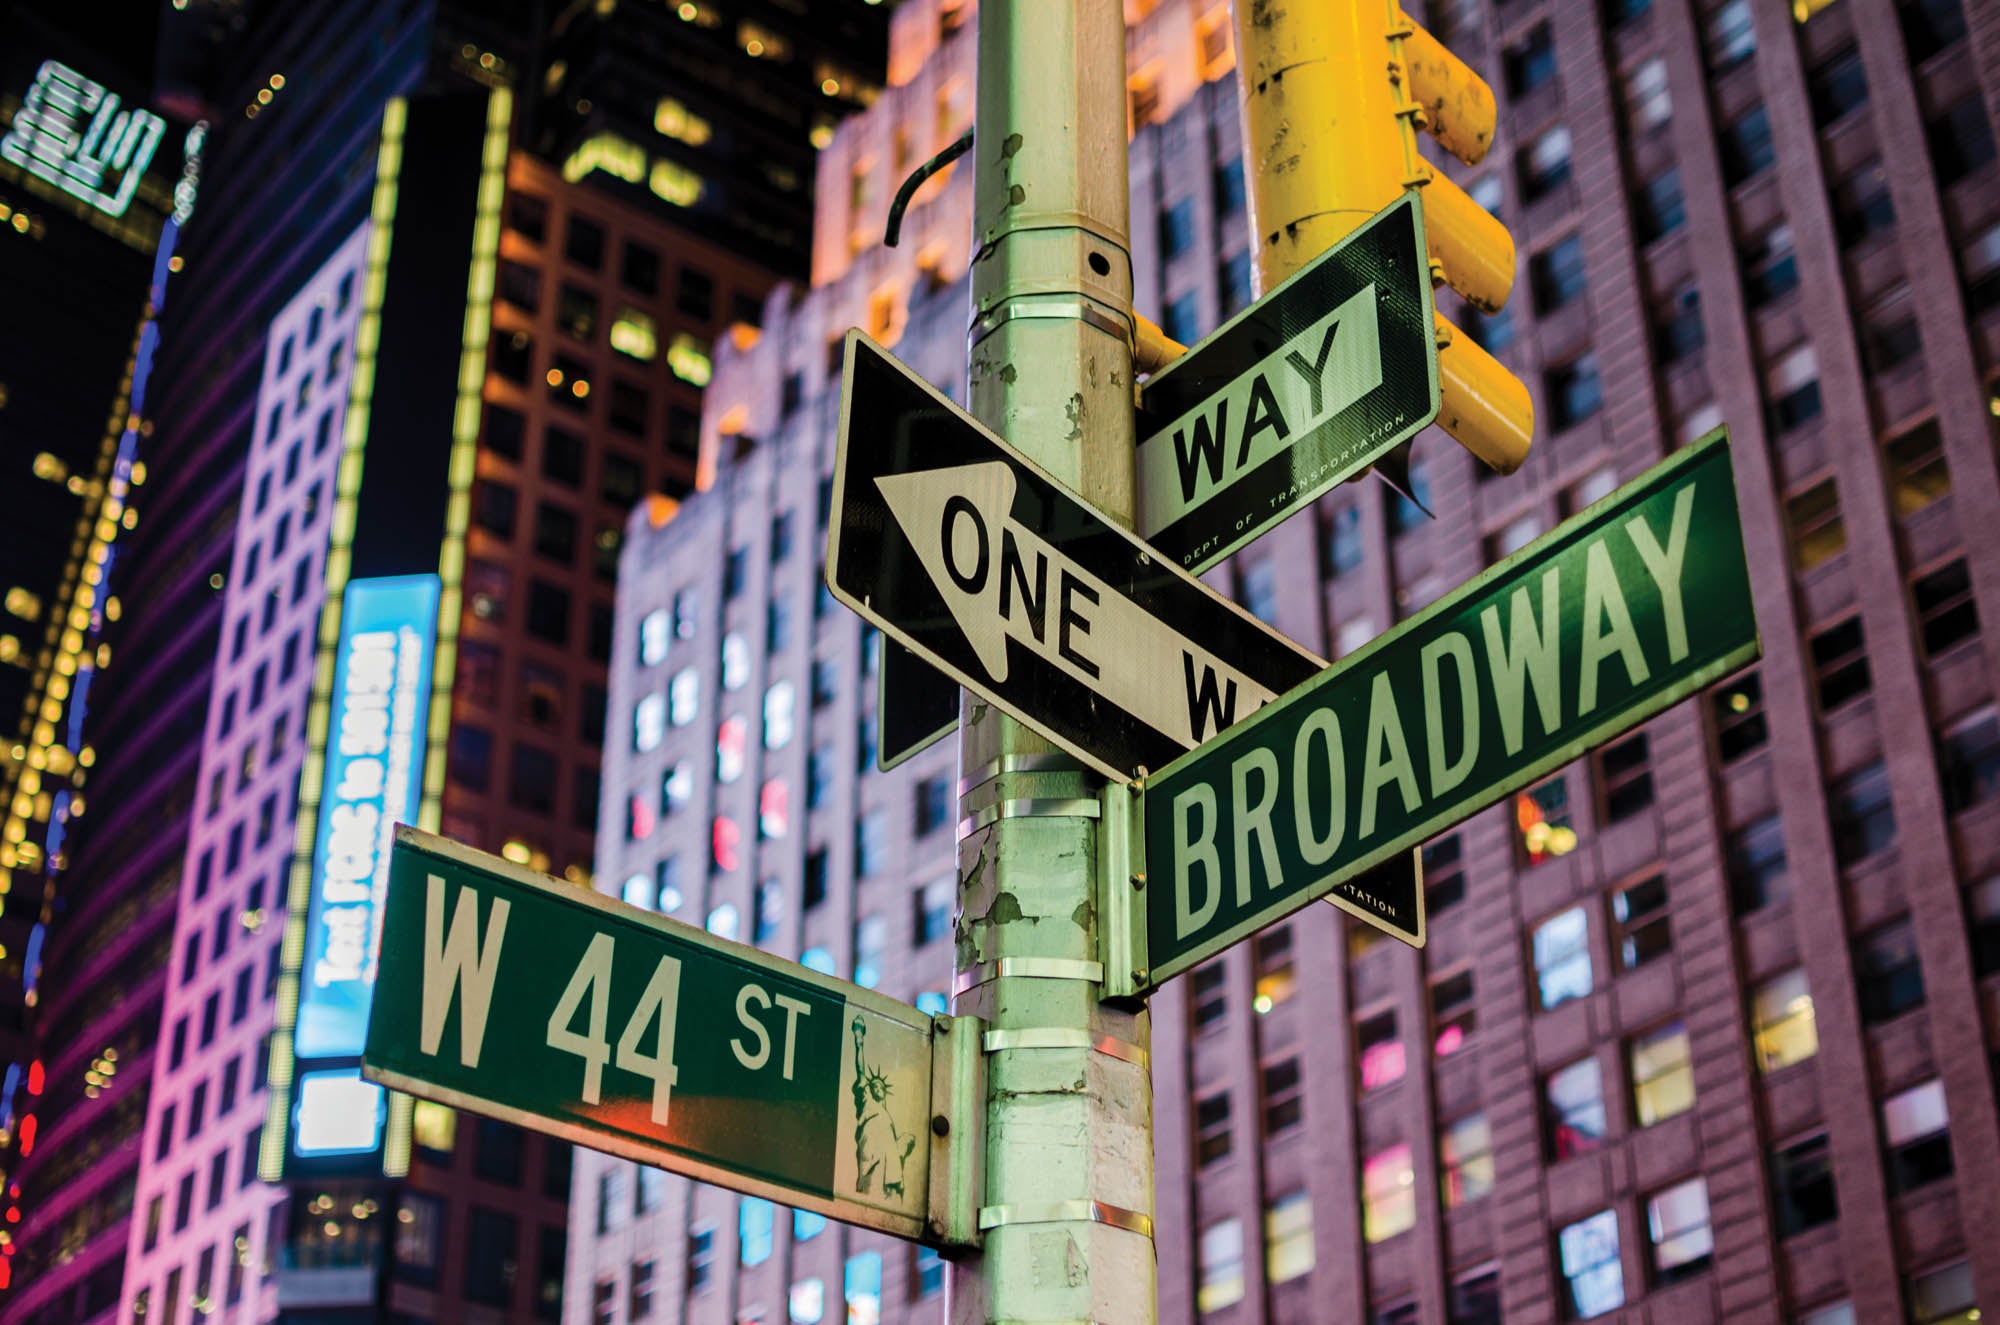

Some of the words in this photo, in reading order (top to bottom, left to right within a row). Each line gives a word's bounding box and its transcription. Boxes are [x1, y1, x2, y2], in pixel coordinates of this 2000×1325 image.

[1172, 318, 1341, 505] WAY
[1184, 535, 1219, 565] DEPT
[1236, 512, 1254, 531] OF
[1269, 413, 1405, 508] TRANSPORTATION
[941, 495, 1100, 680] ONE
[1173, 482, 1696, 941] BROADWAY
[420, 873, 511, 1069] W
[546, 932, 682, 1127] 44
[729, 983, 811, 1081] ST
